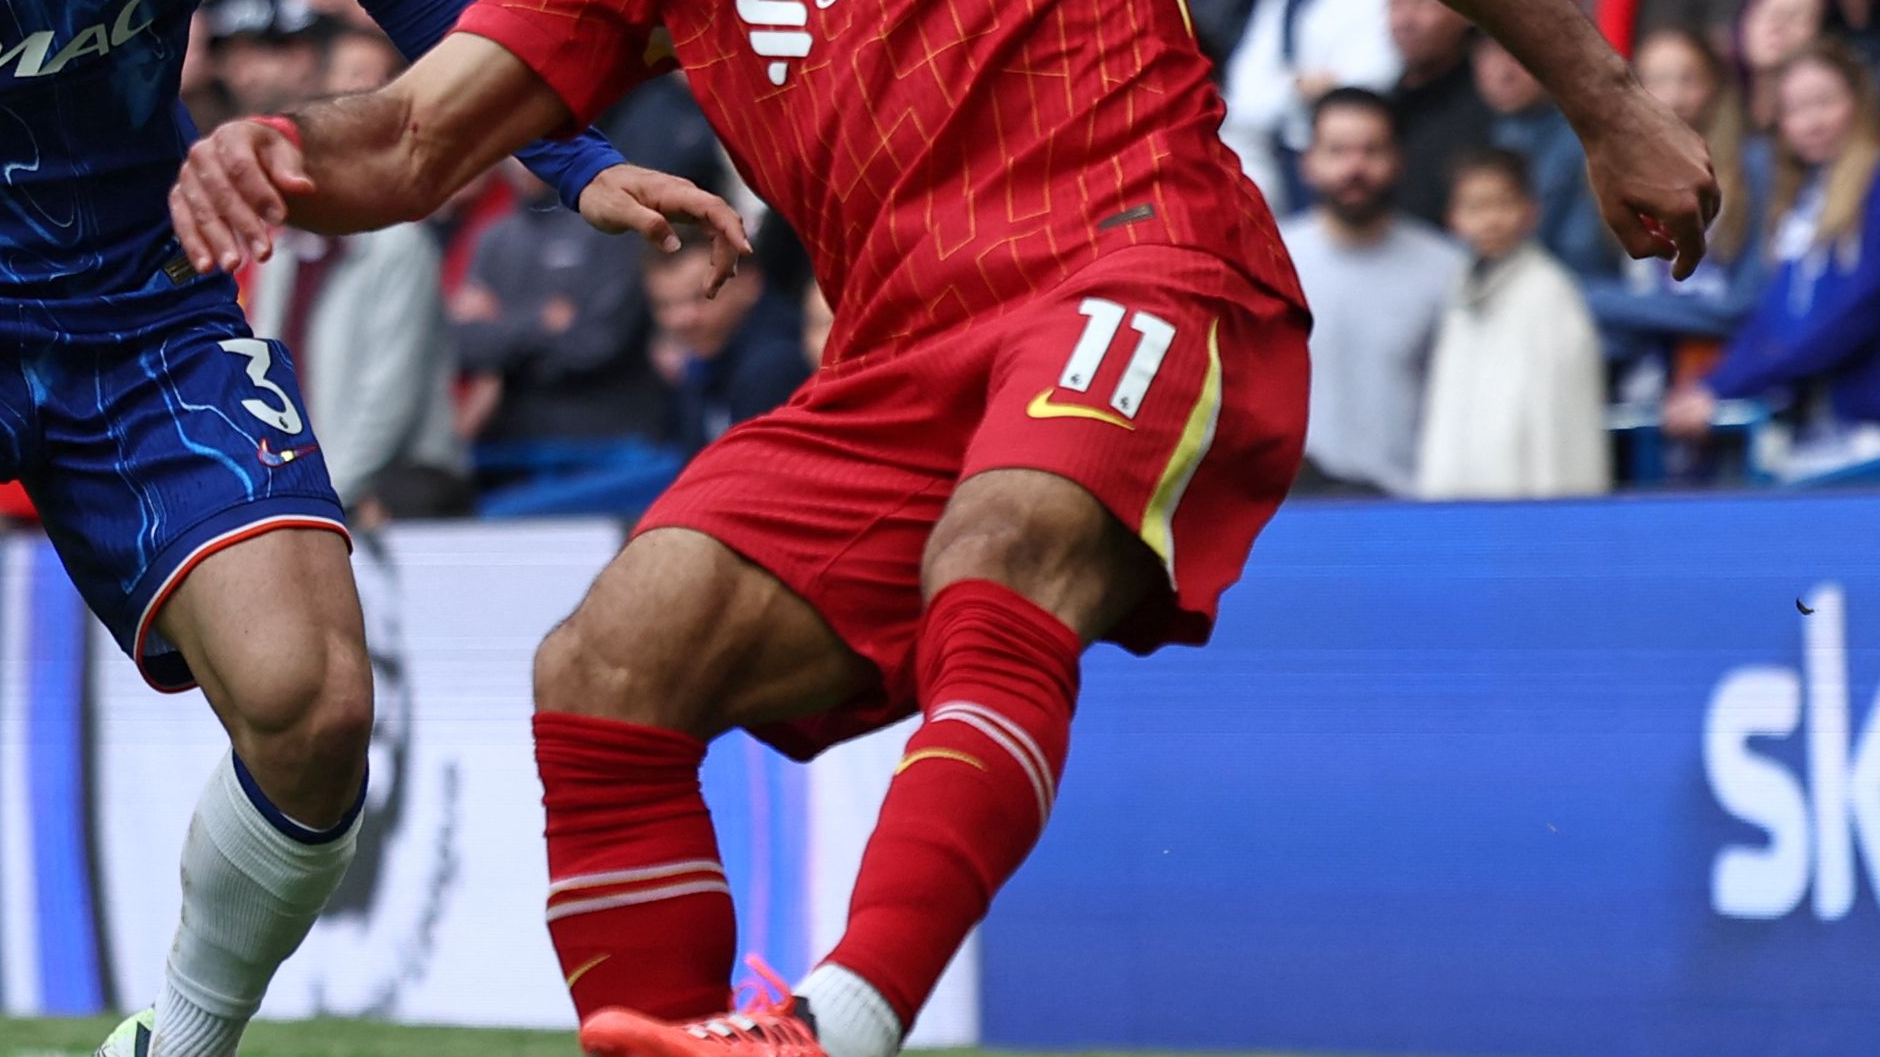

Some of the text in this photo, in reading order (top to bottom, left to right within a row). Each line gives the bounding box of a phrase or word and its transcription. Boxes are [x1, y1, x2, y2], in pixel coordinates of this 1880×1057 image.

[218, 338, 304, 435] 3
[1058, 297, 1177, 420] 11
[1702, 582, 1880, 921] sk
